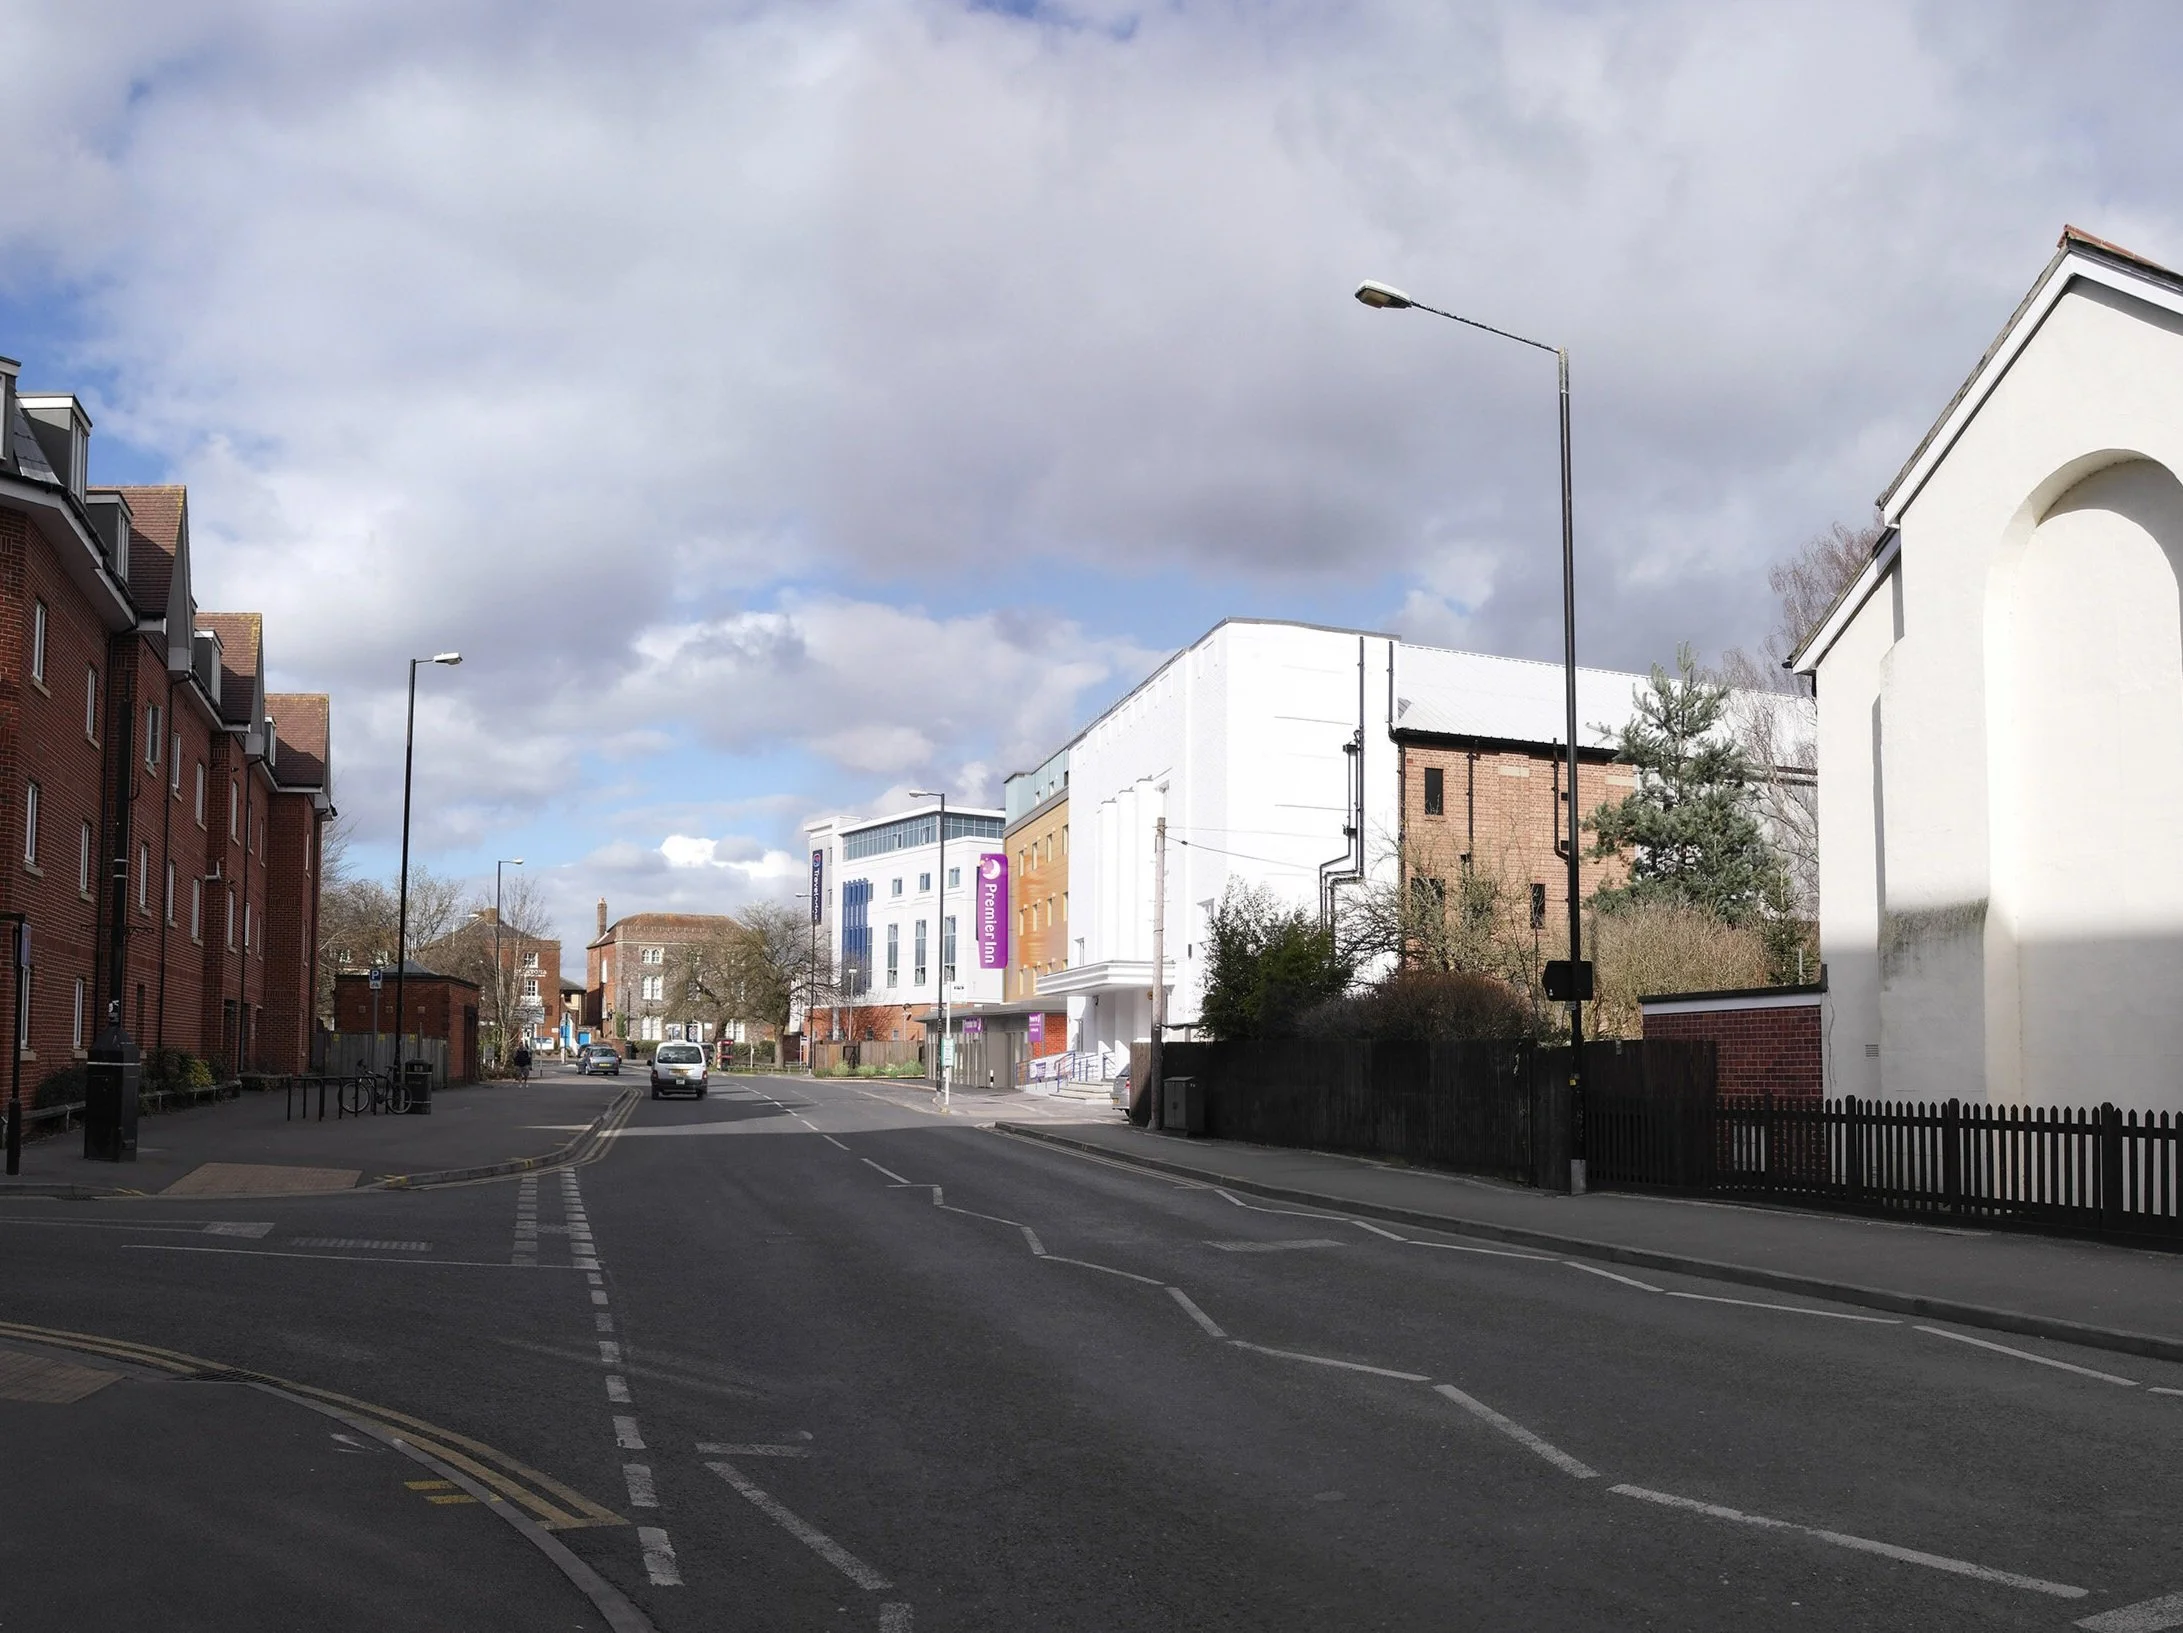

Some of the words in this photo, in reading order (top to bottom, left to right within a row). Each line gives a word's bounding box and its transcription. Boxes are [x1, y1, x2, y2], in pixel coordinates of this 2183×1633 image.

[984, 883, 997, 940] Premier
[984, 941, 997, 964] Inn
[371, 970, 380, 980] P
